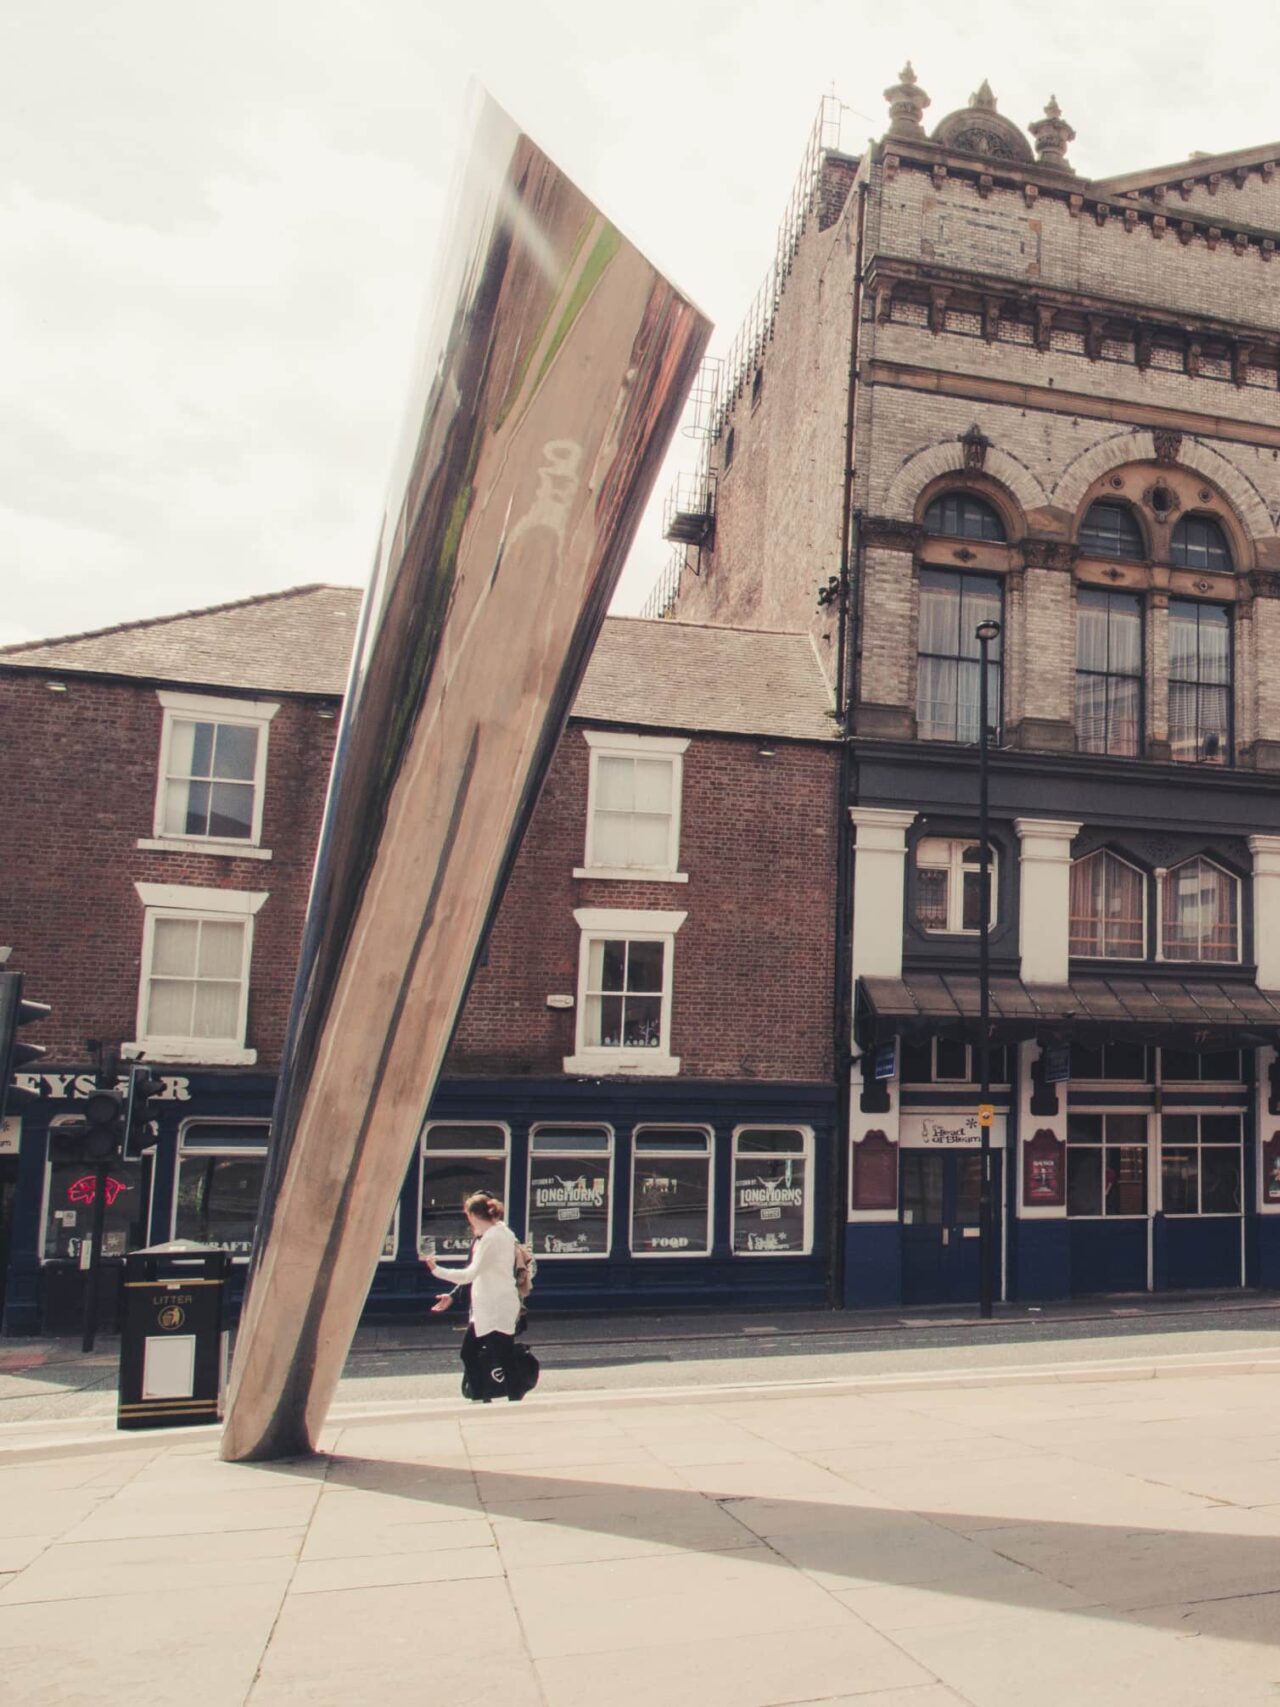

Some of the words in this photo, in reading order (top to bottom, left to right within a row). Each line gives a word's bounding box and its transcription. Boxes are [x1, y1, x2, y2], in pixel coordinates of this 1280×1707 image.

[14, 1073, 97, 1099] EYS
[536, 1187, 603, 1207] LONGHORNS
[739, 1187, 802, 1207] LONGHORNS
[442, 1239, 473, 1250] CAS
[651, 1236, 689, 1248] FOOD
[153, 1295, 192, 1305] LITTER
